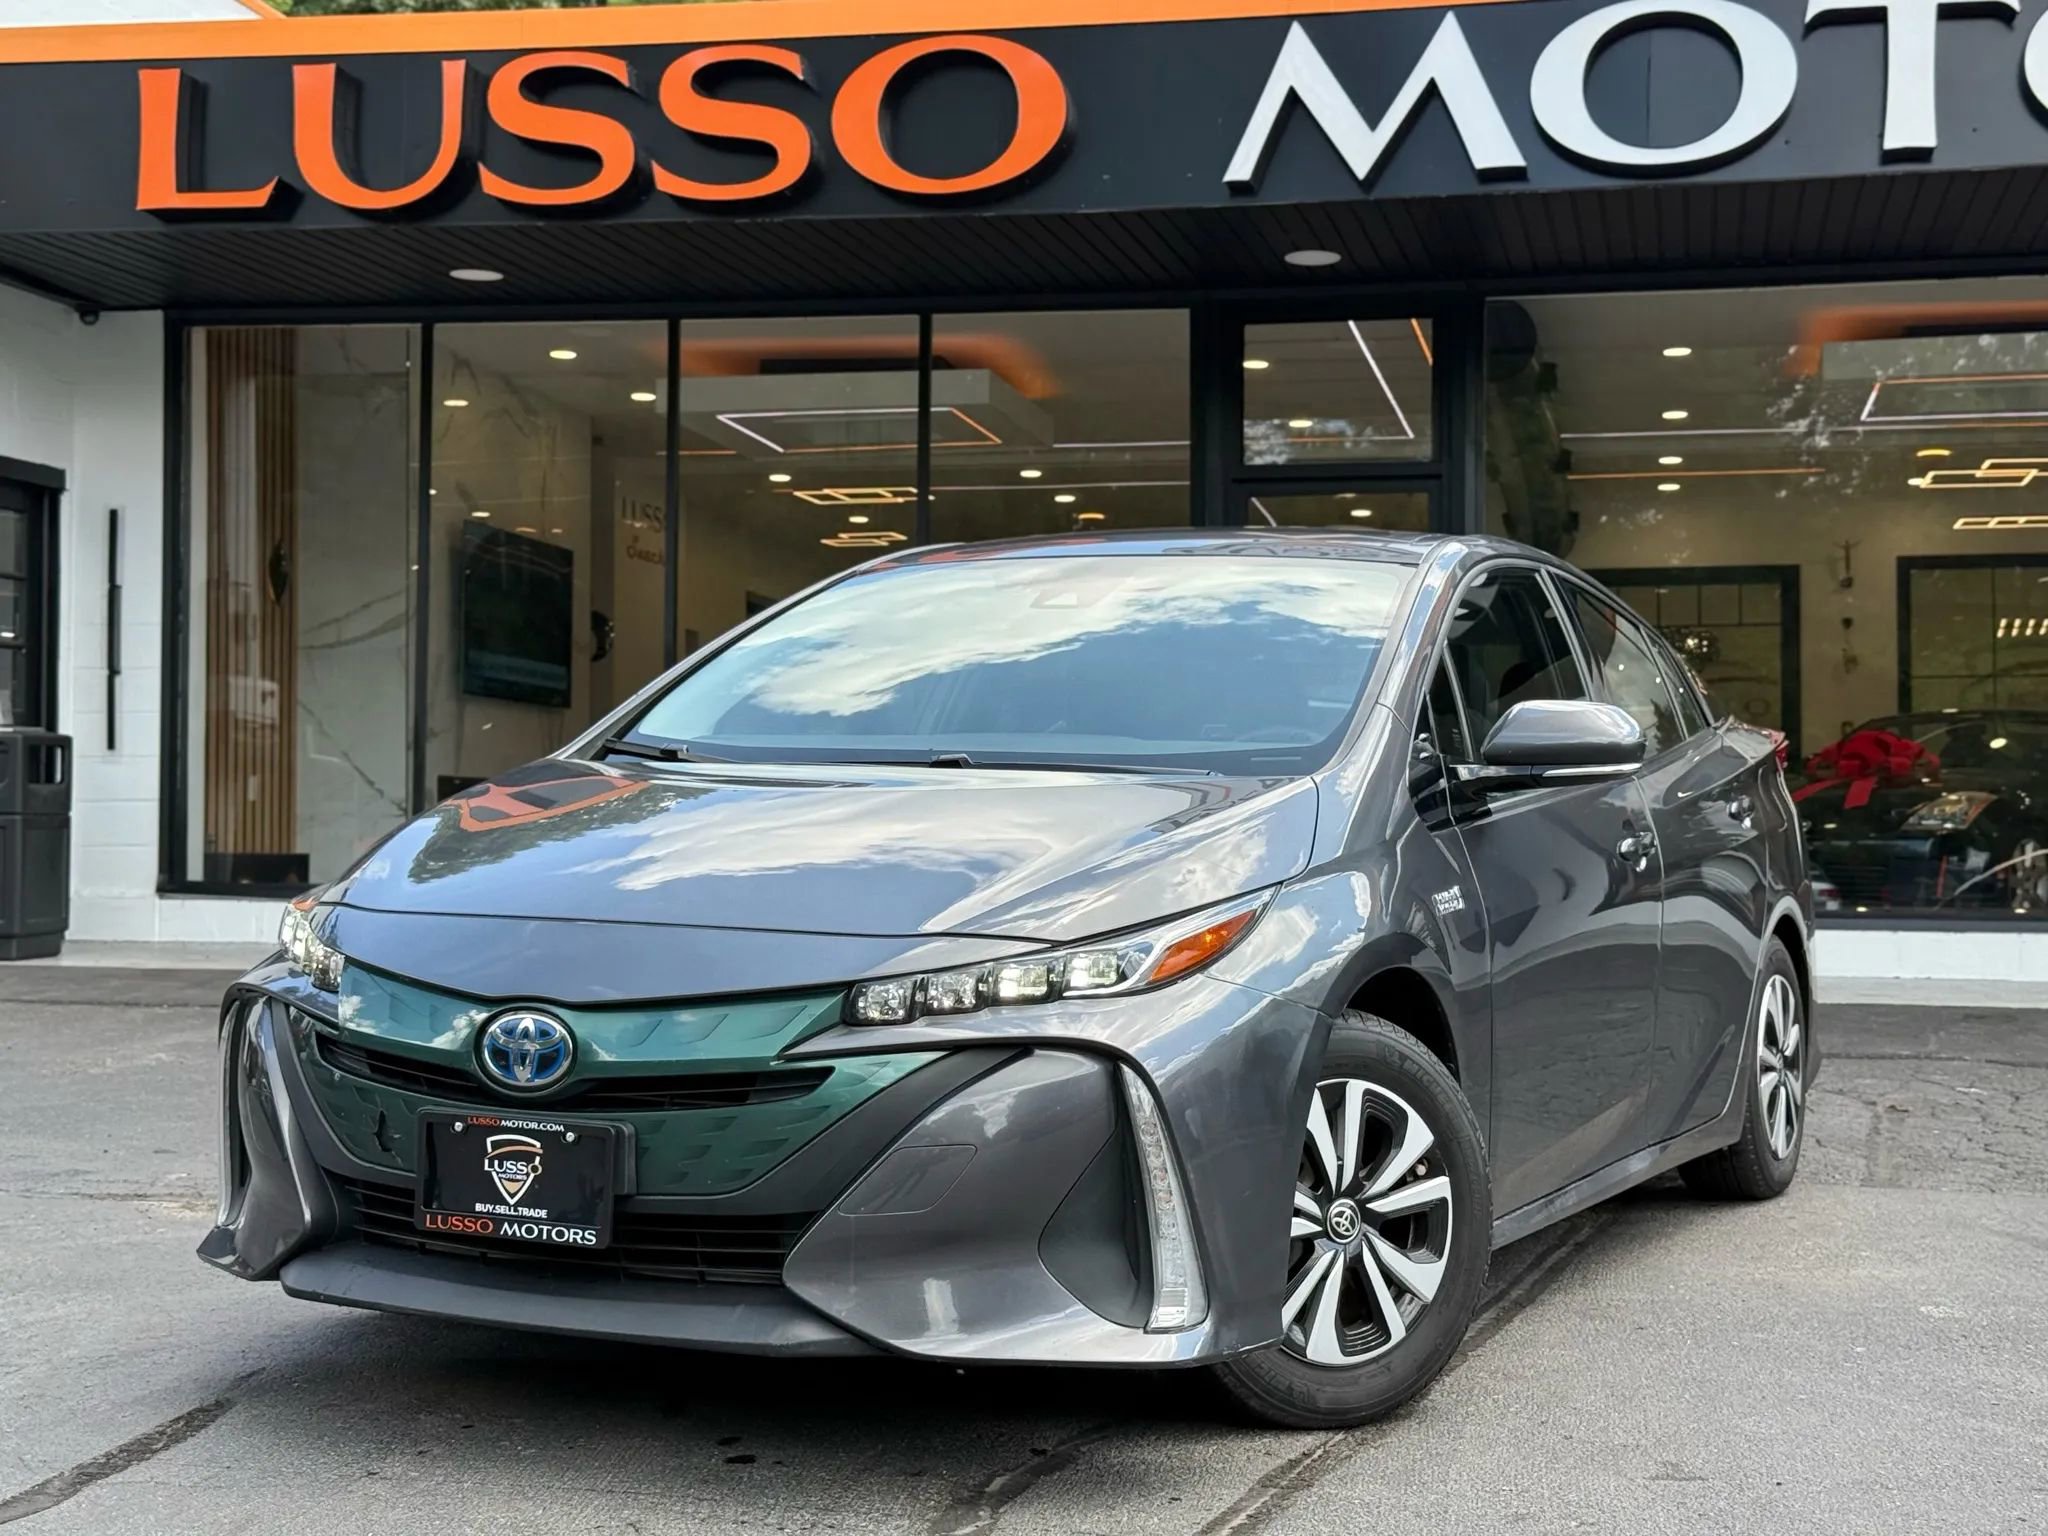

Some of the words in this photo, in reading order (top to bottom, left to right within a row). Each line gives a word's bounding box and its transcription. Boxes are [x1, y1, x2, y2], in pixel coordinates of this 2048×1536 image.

[136, 34, 1069, 211] LUSSO
[1222, 0, 2048, 188] MOT
[484, 1158, 542, 1175] LUSSO
[426, 1214, 493, 1234] LUSSO
[500, 1222, 597, 1245] MOTORS
